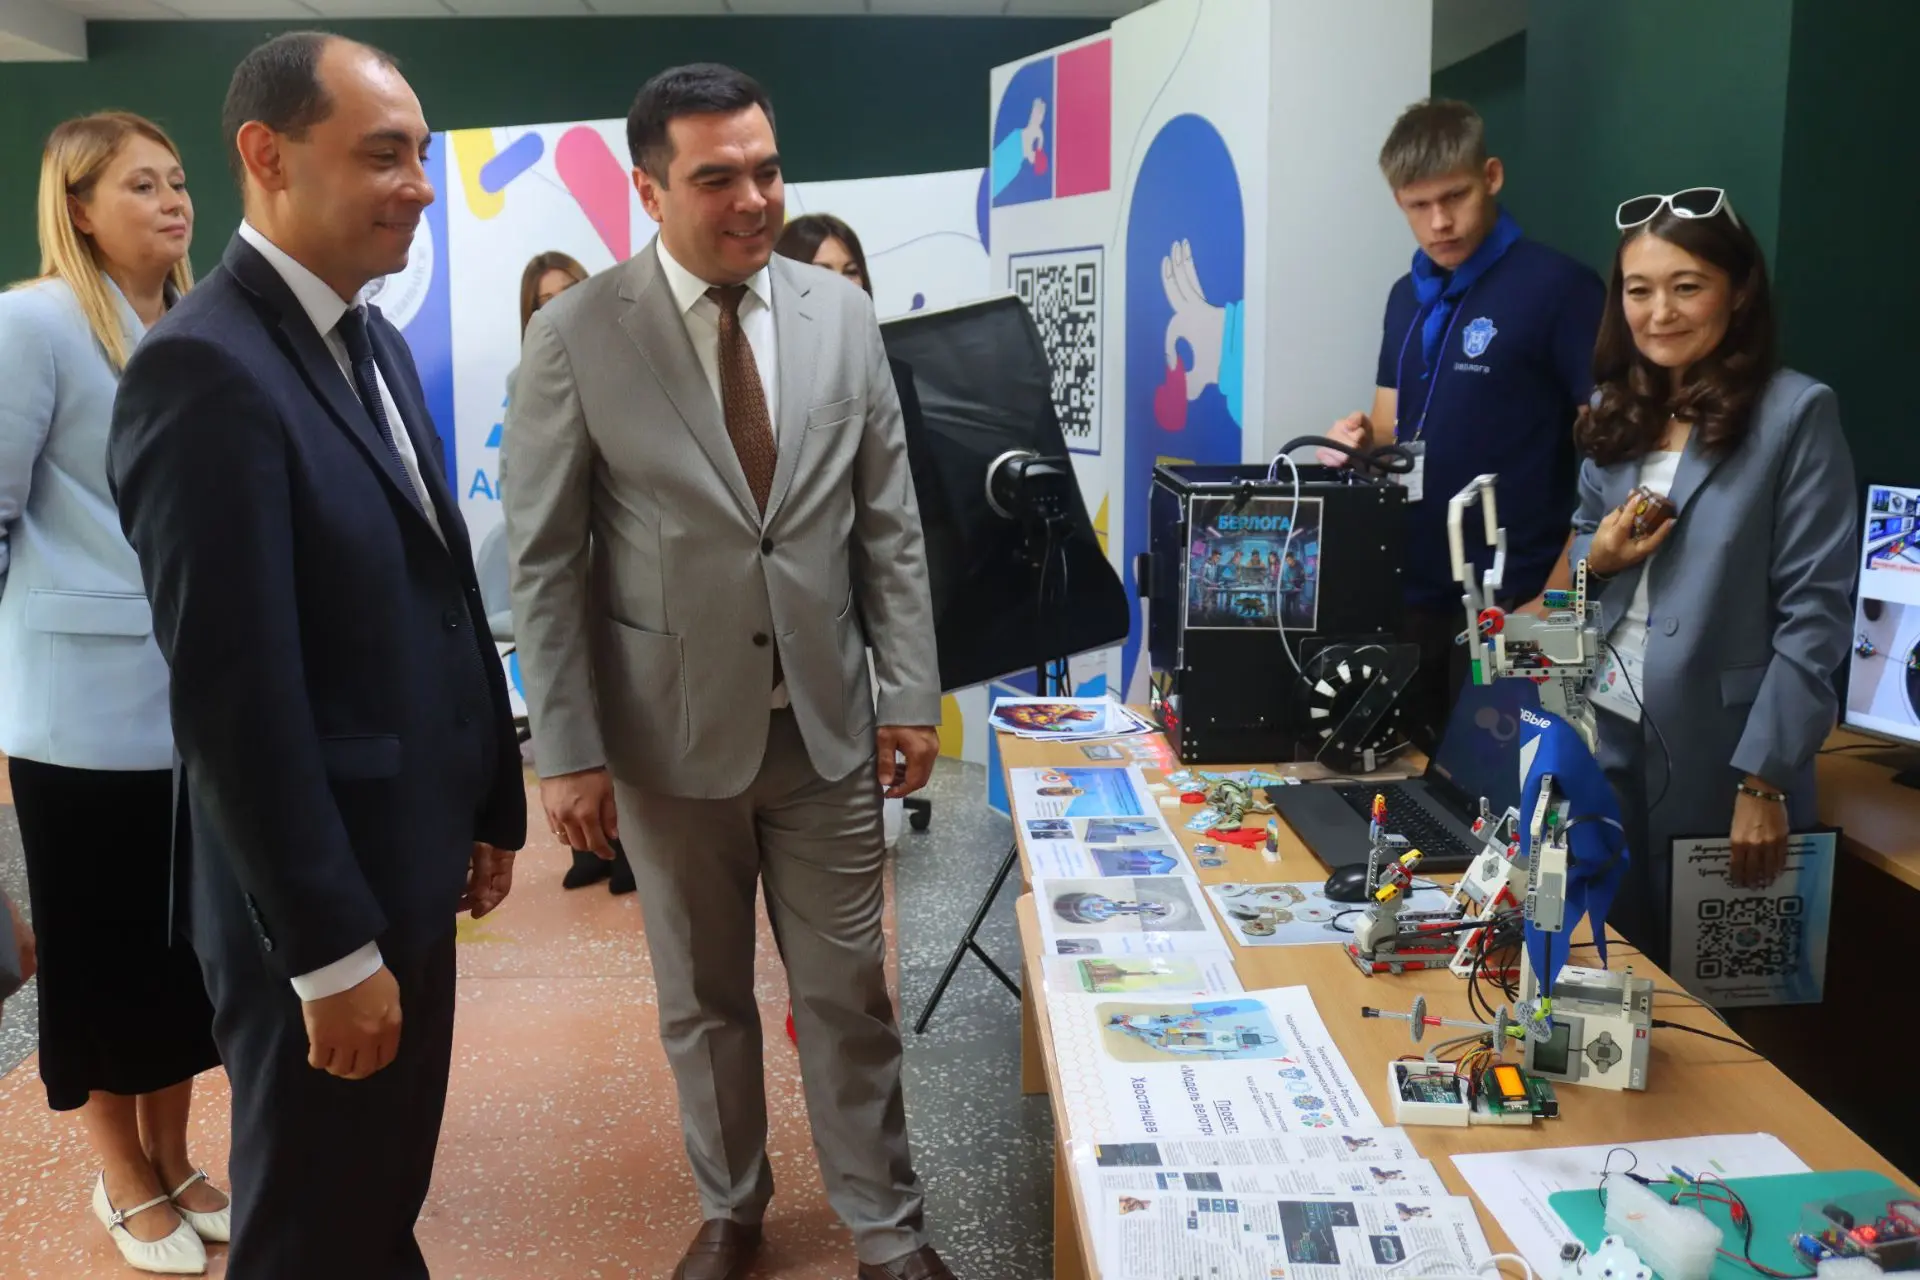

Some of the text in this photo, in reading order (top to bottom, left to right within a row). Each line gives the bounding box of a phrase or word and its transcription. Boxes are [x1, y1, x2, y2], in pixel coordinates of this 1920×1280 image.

[1217, 514, 1292, 531] БЕРЛОГА
[1130, 1076, 1158, 1133] Хвостанцев
[1215, 1099, 1239, 1134] Проект:
